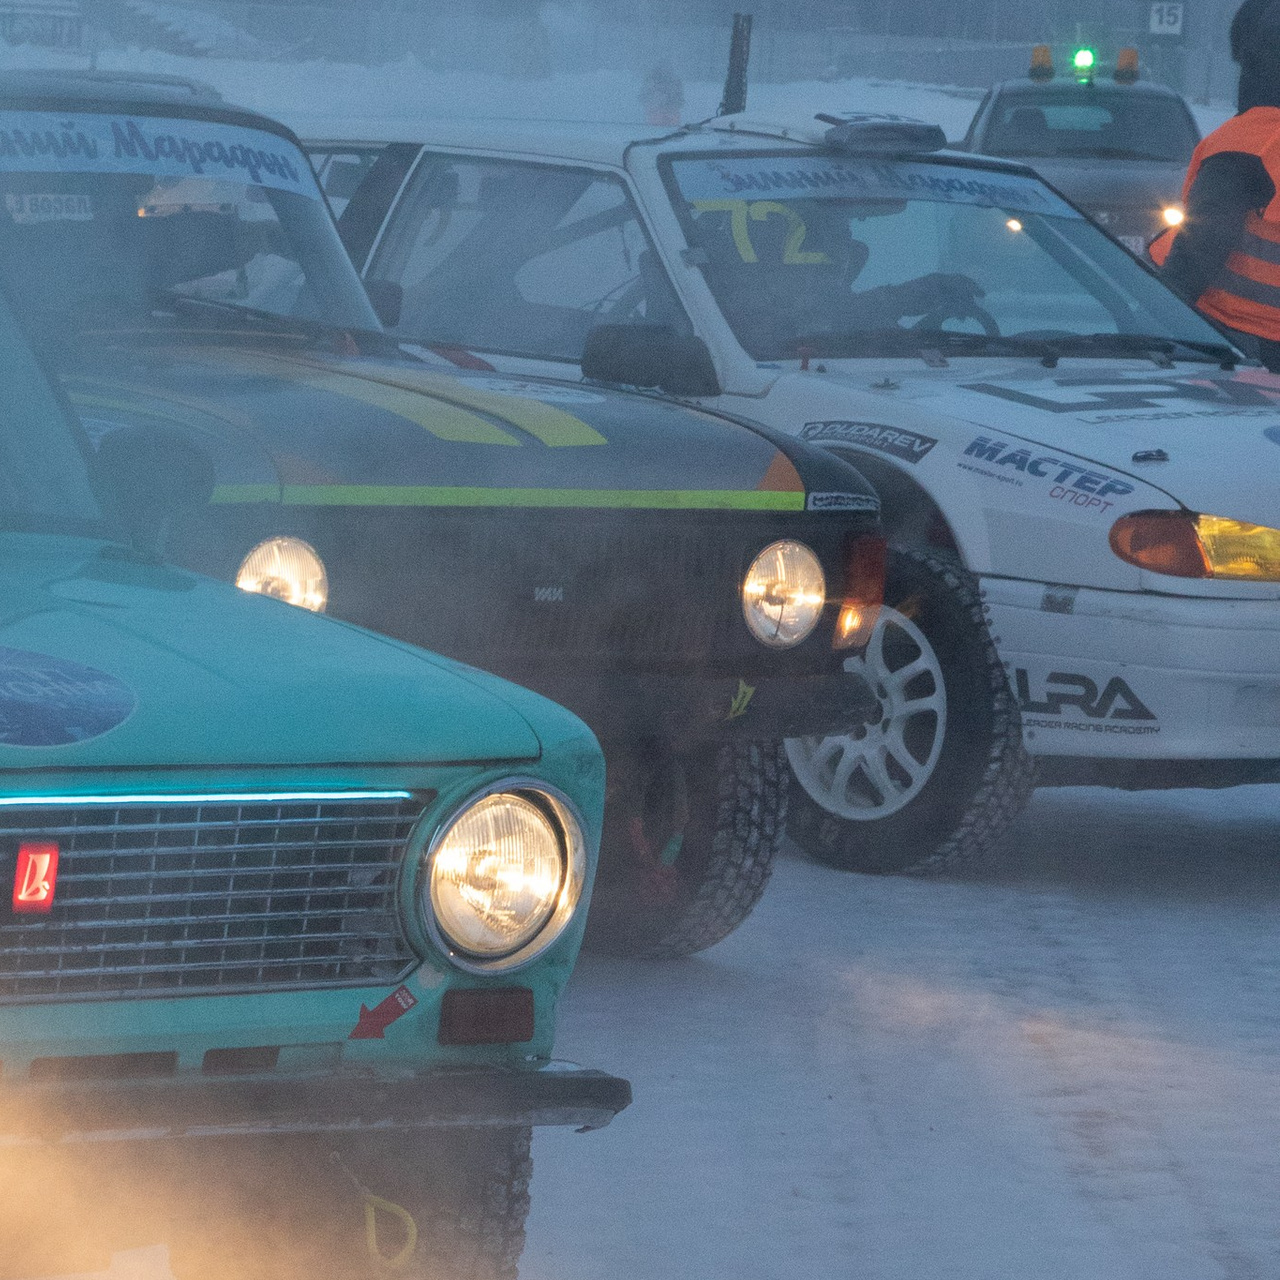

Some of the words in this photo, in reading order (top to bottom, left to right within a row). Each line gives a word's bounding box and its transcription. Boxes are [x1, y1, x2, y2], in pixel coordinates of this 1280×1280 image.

[693, 199, 834, 265] 72
[822, 423, 932, 453] DUDAREV
[964, 436, 1134, 499] МАСТЕР
[1048, 485, 1114, 515] СПОРТ
[1016, 669, 1158, 722] LRA
